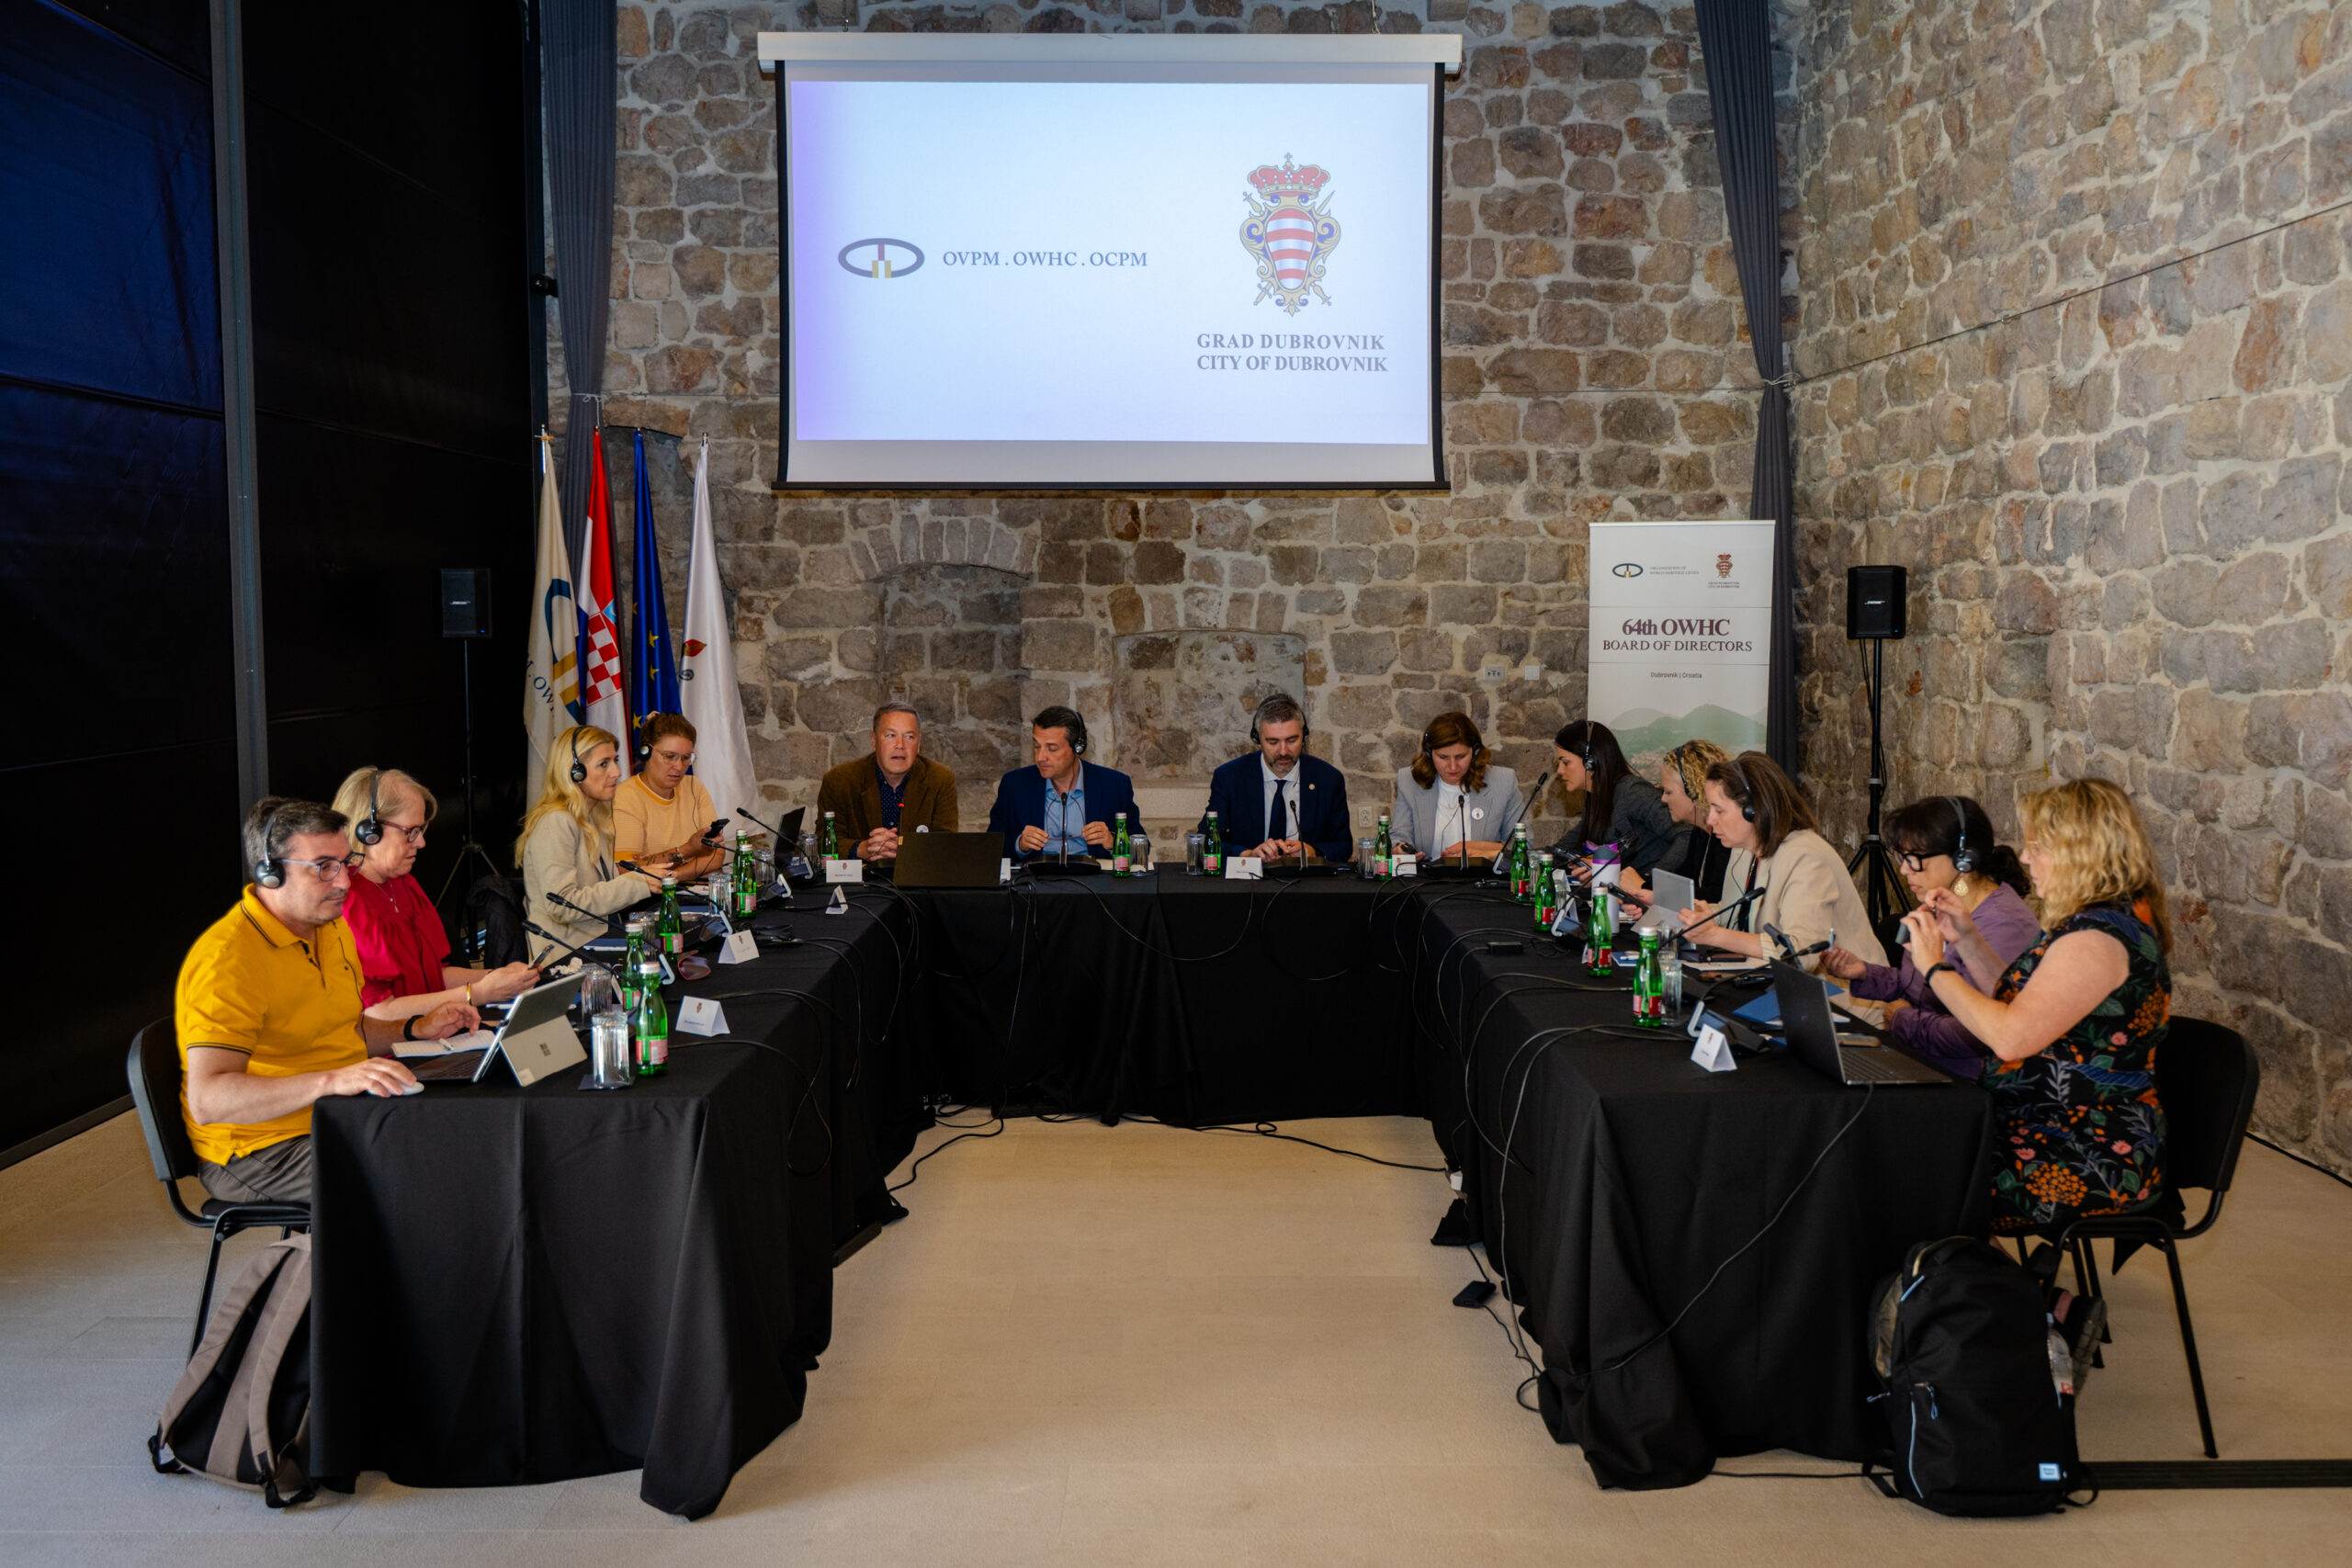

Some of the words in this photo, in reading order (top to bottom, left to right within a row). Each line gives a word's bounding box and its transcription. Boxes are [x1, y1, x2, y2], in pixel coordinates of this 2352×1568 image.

[943, 251, 1000, 266] OVPM
[1012, 251, 1077, 266] OWHC
[1089, 252, 1148, 267] OCPM
[1196, 333, 1255, 349] GRAD
[1260, 333, 1385, 350] DUBROVNIK
[1196, 355, 1242, 370] CITY
[1246, 355, 1272, 371] OF
[1274, 355, 1389, 372] DUBROVNIK
[1622, 618, 1658, 636] 64th
[1660, 618, 1731, 637] OWHC
[1602, 639, 1651, 651] BOARD
[1653, 640, 1672, 651] OF
[1674, 640, 1753, 652] DIRECTORS
